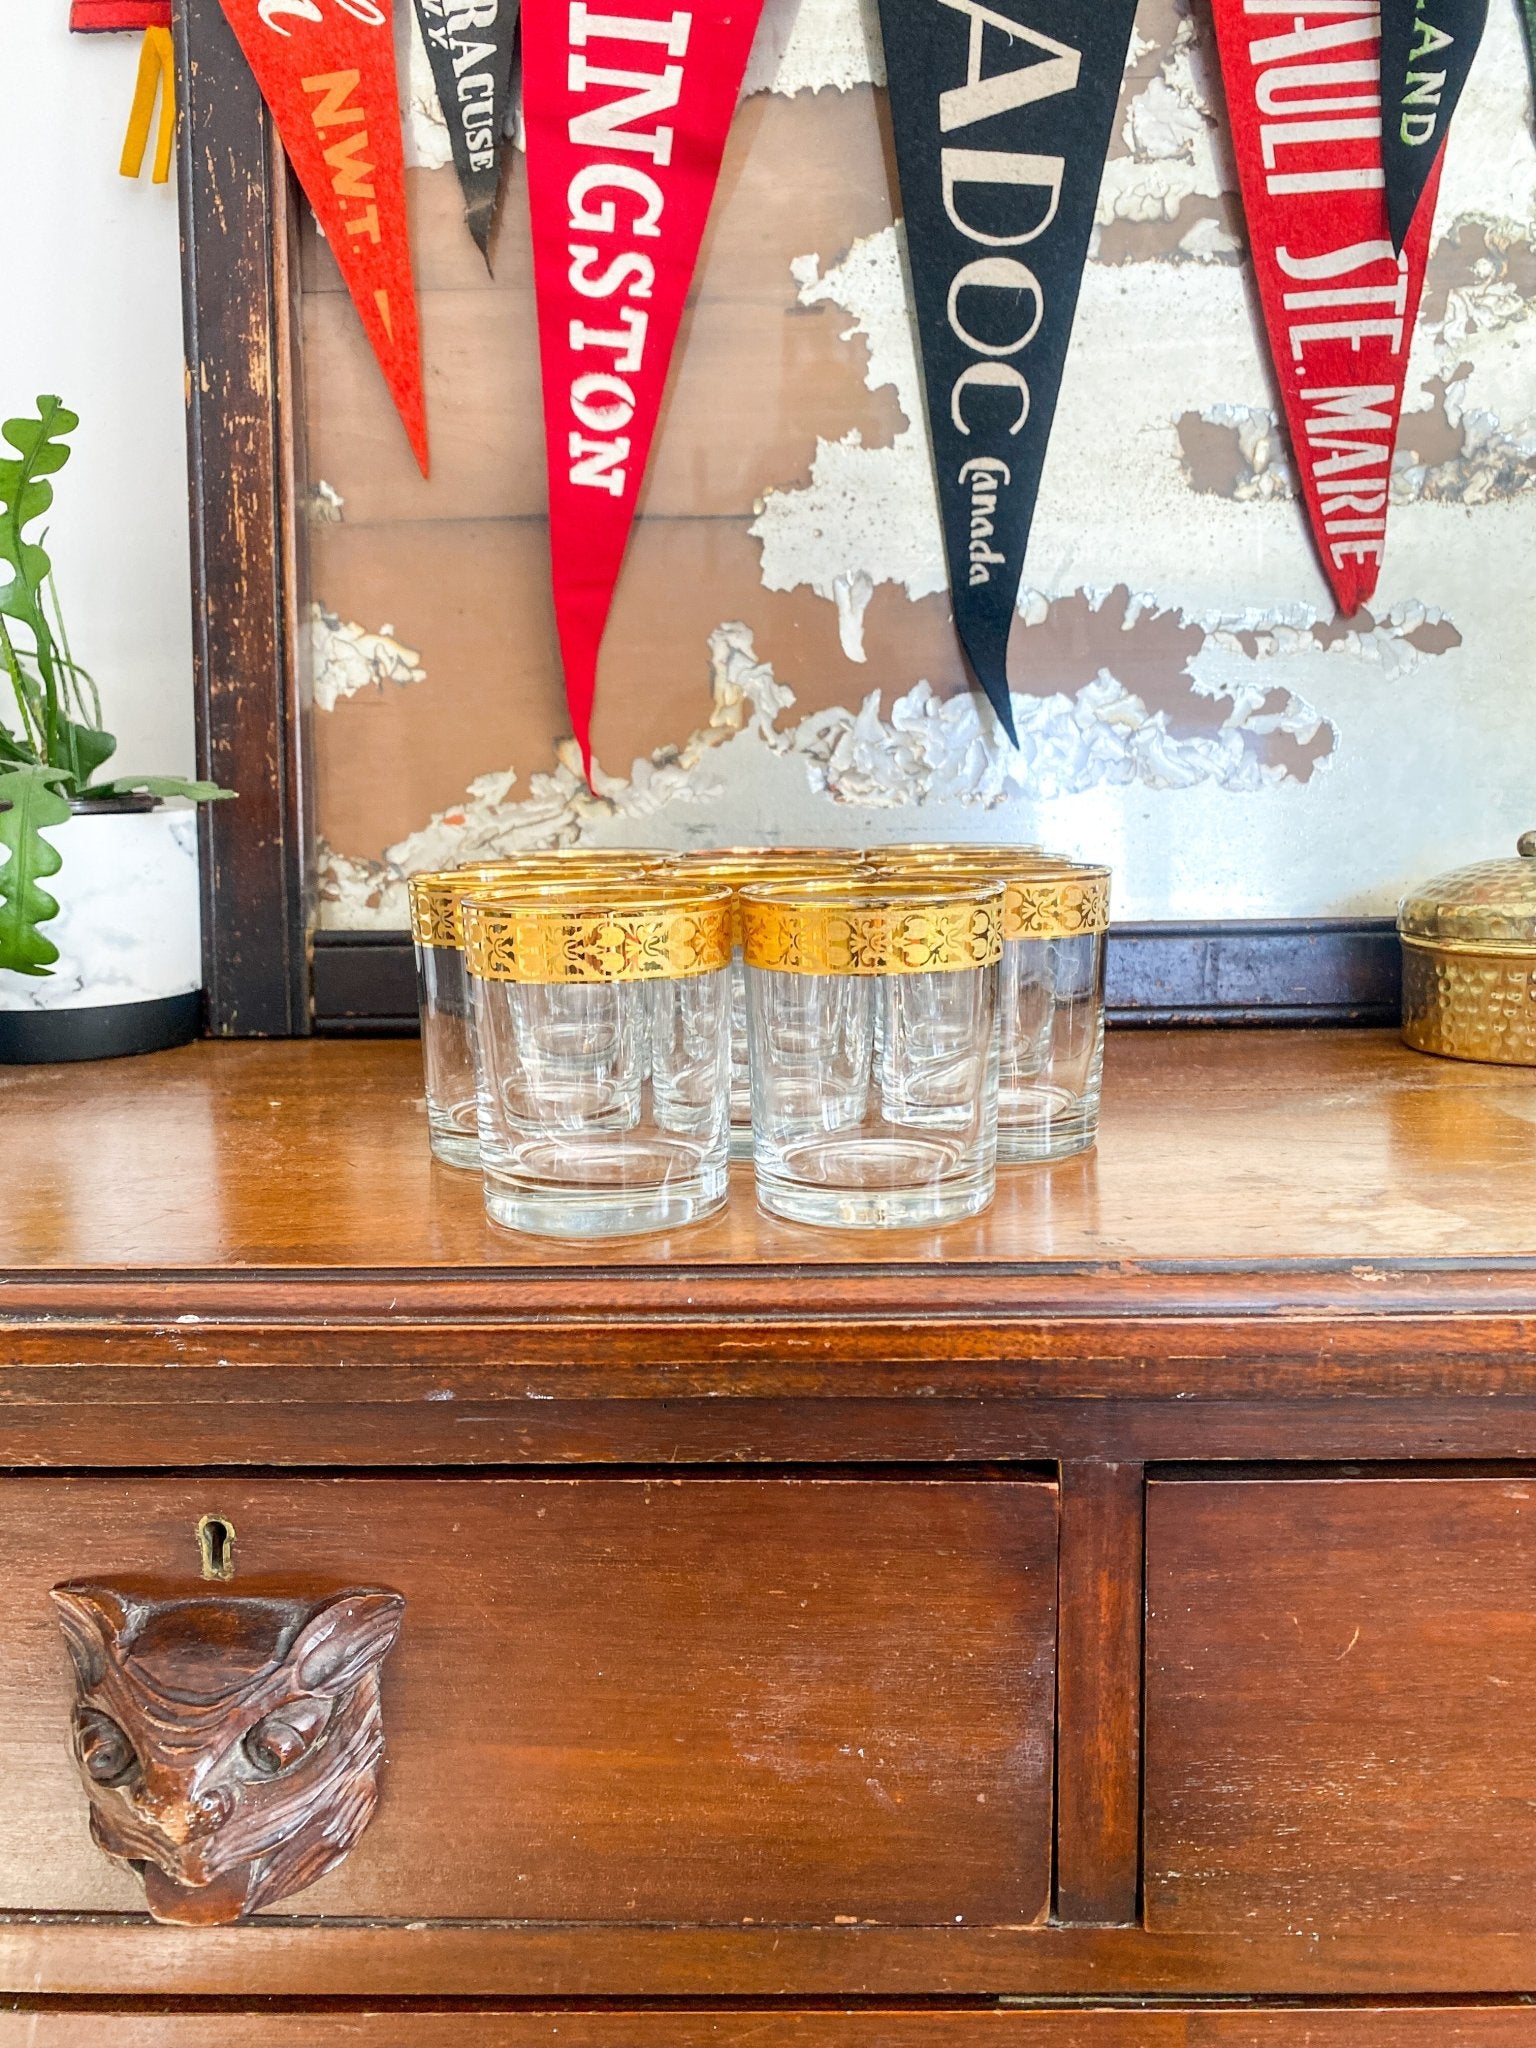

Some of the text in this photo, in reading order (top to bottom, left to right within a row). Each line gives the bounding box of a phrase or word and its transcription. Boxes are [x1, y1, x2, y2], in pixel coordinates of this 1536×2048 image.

[301, 68, 382, 254] N.W.T.
[567, 1, 693, 497] INGSTON
[937, 0, 1083, 587] ADOC Canada
[1275, 239, 1409, 375] STE.
[1299, 384, 1396, 570] MARIE
